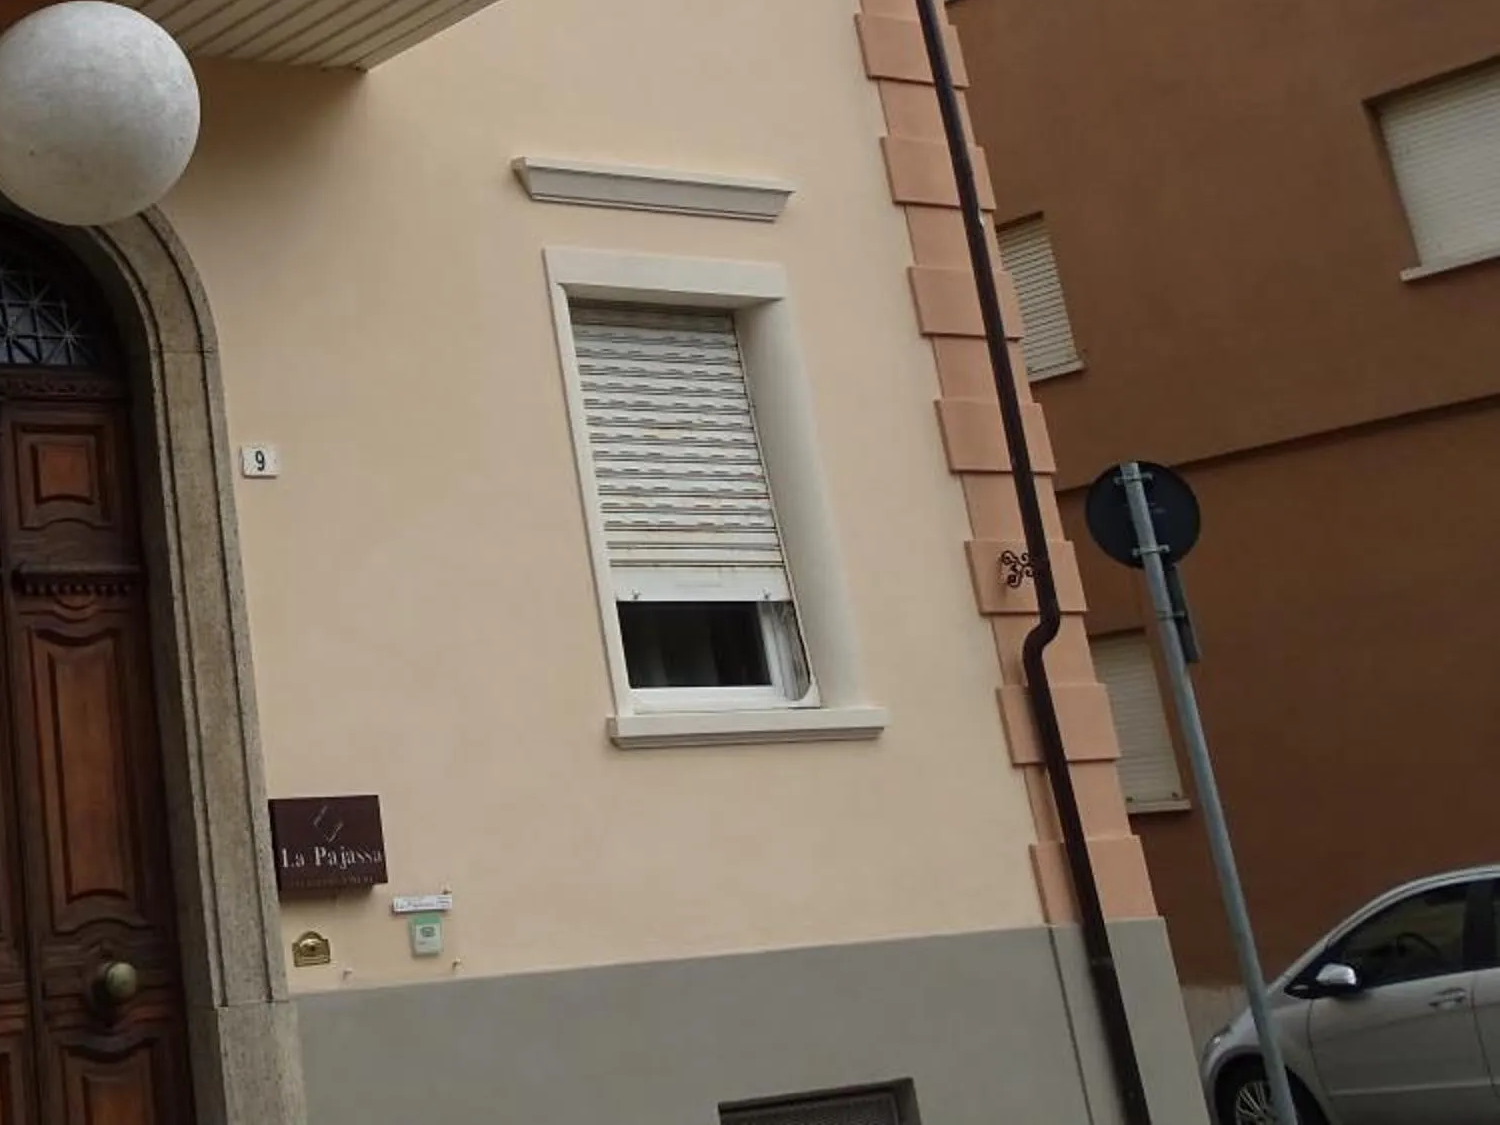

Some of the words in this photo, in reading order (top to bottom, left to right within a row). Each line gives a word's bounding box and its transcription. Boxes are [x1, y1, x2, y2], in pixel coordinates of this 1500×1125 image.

[255, 450, 265, 472] 9
[281, 848, 305, 868] La
[314, 846, 382, 870] Pajassa
